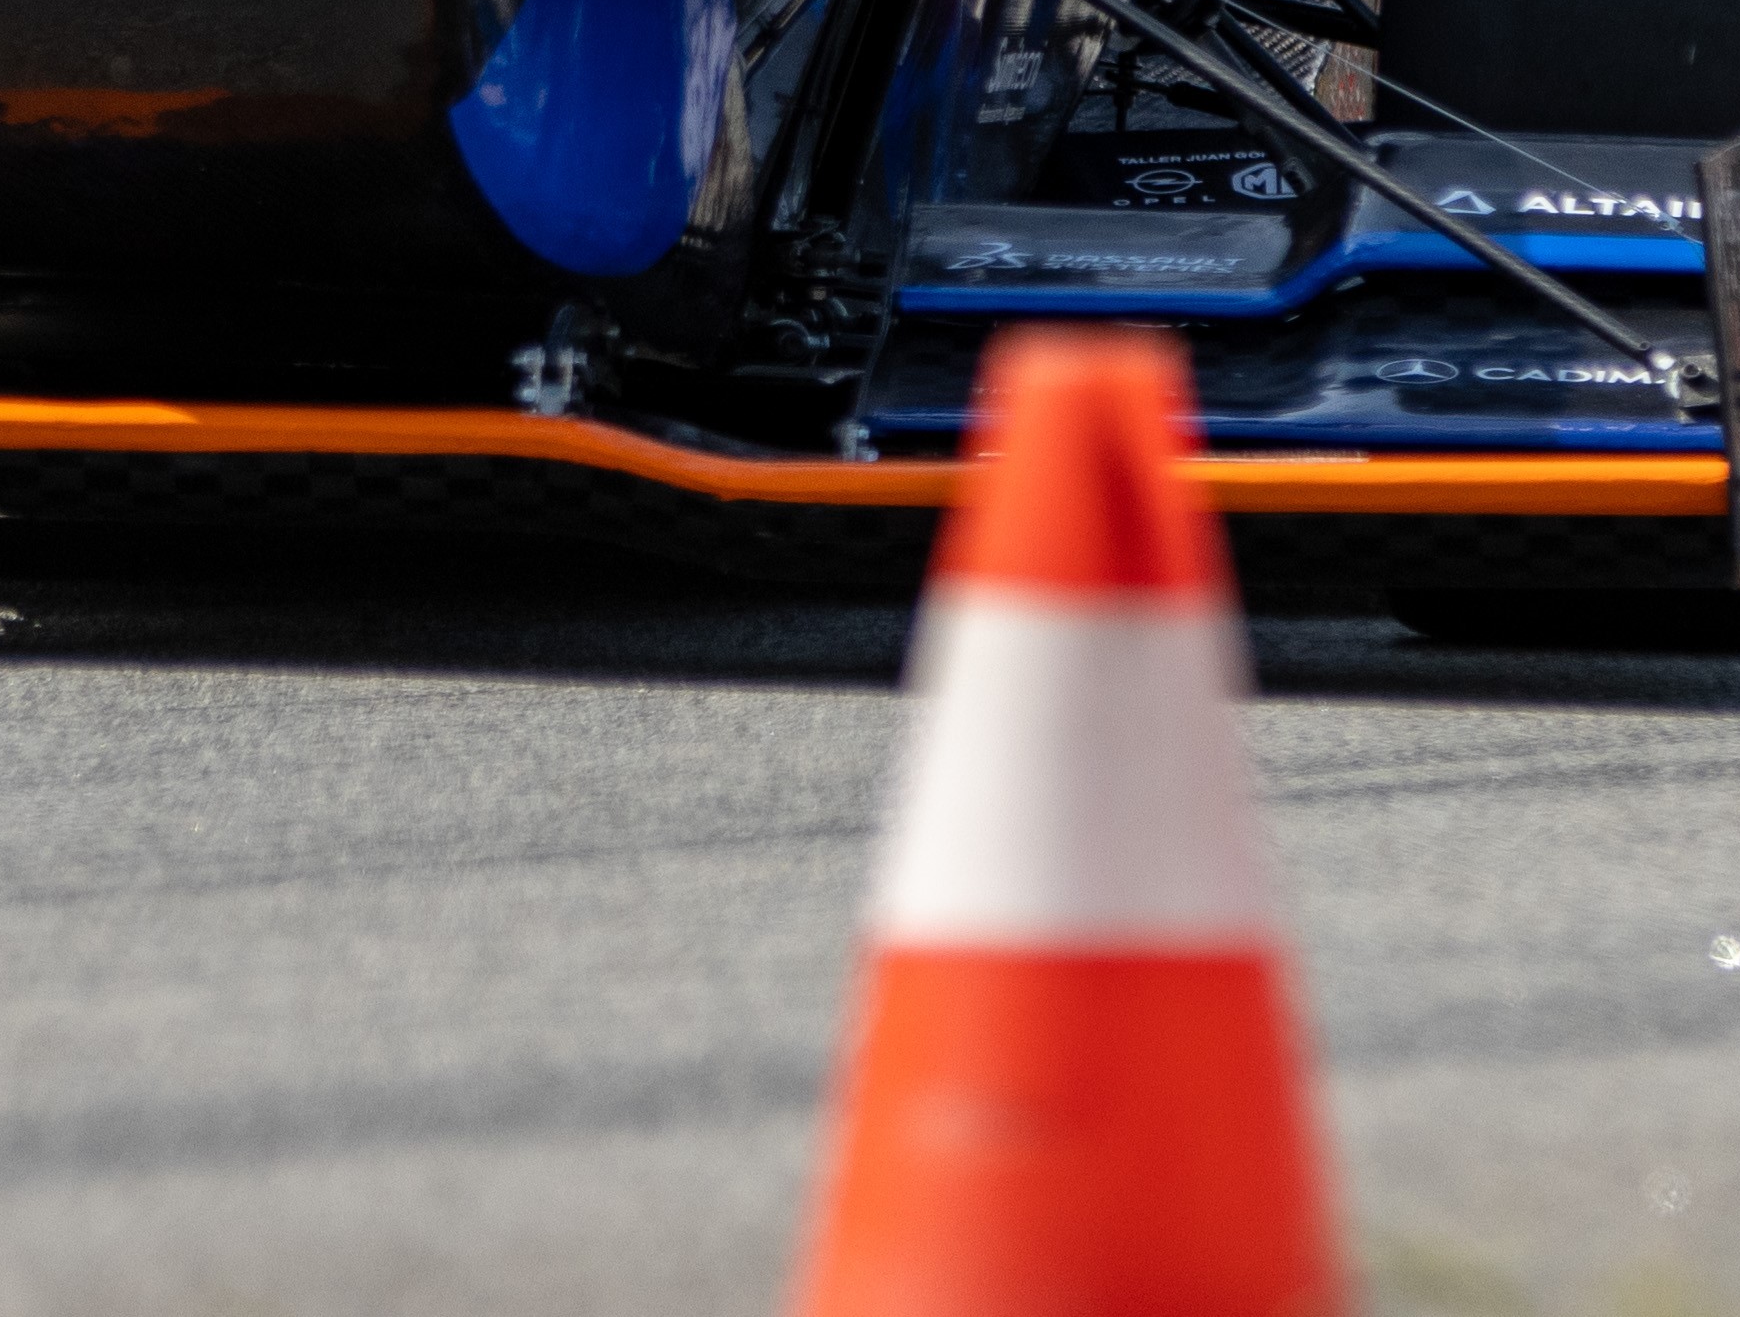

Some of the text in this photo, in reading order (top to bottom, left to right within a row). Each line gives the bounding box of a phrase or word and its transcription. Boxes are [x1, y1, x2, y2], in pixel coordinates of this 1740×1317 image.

[1118, 155, 1182, 165] TALLER
[1186, 152, 1231, 163] JUAN
[1112, 195, 1216, 206] OPEL
[1474, 366, 1666, 385] CADIM
